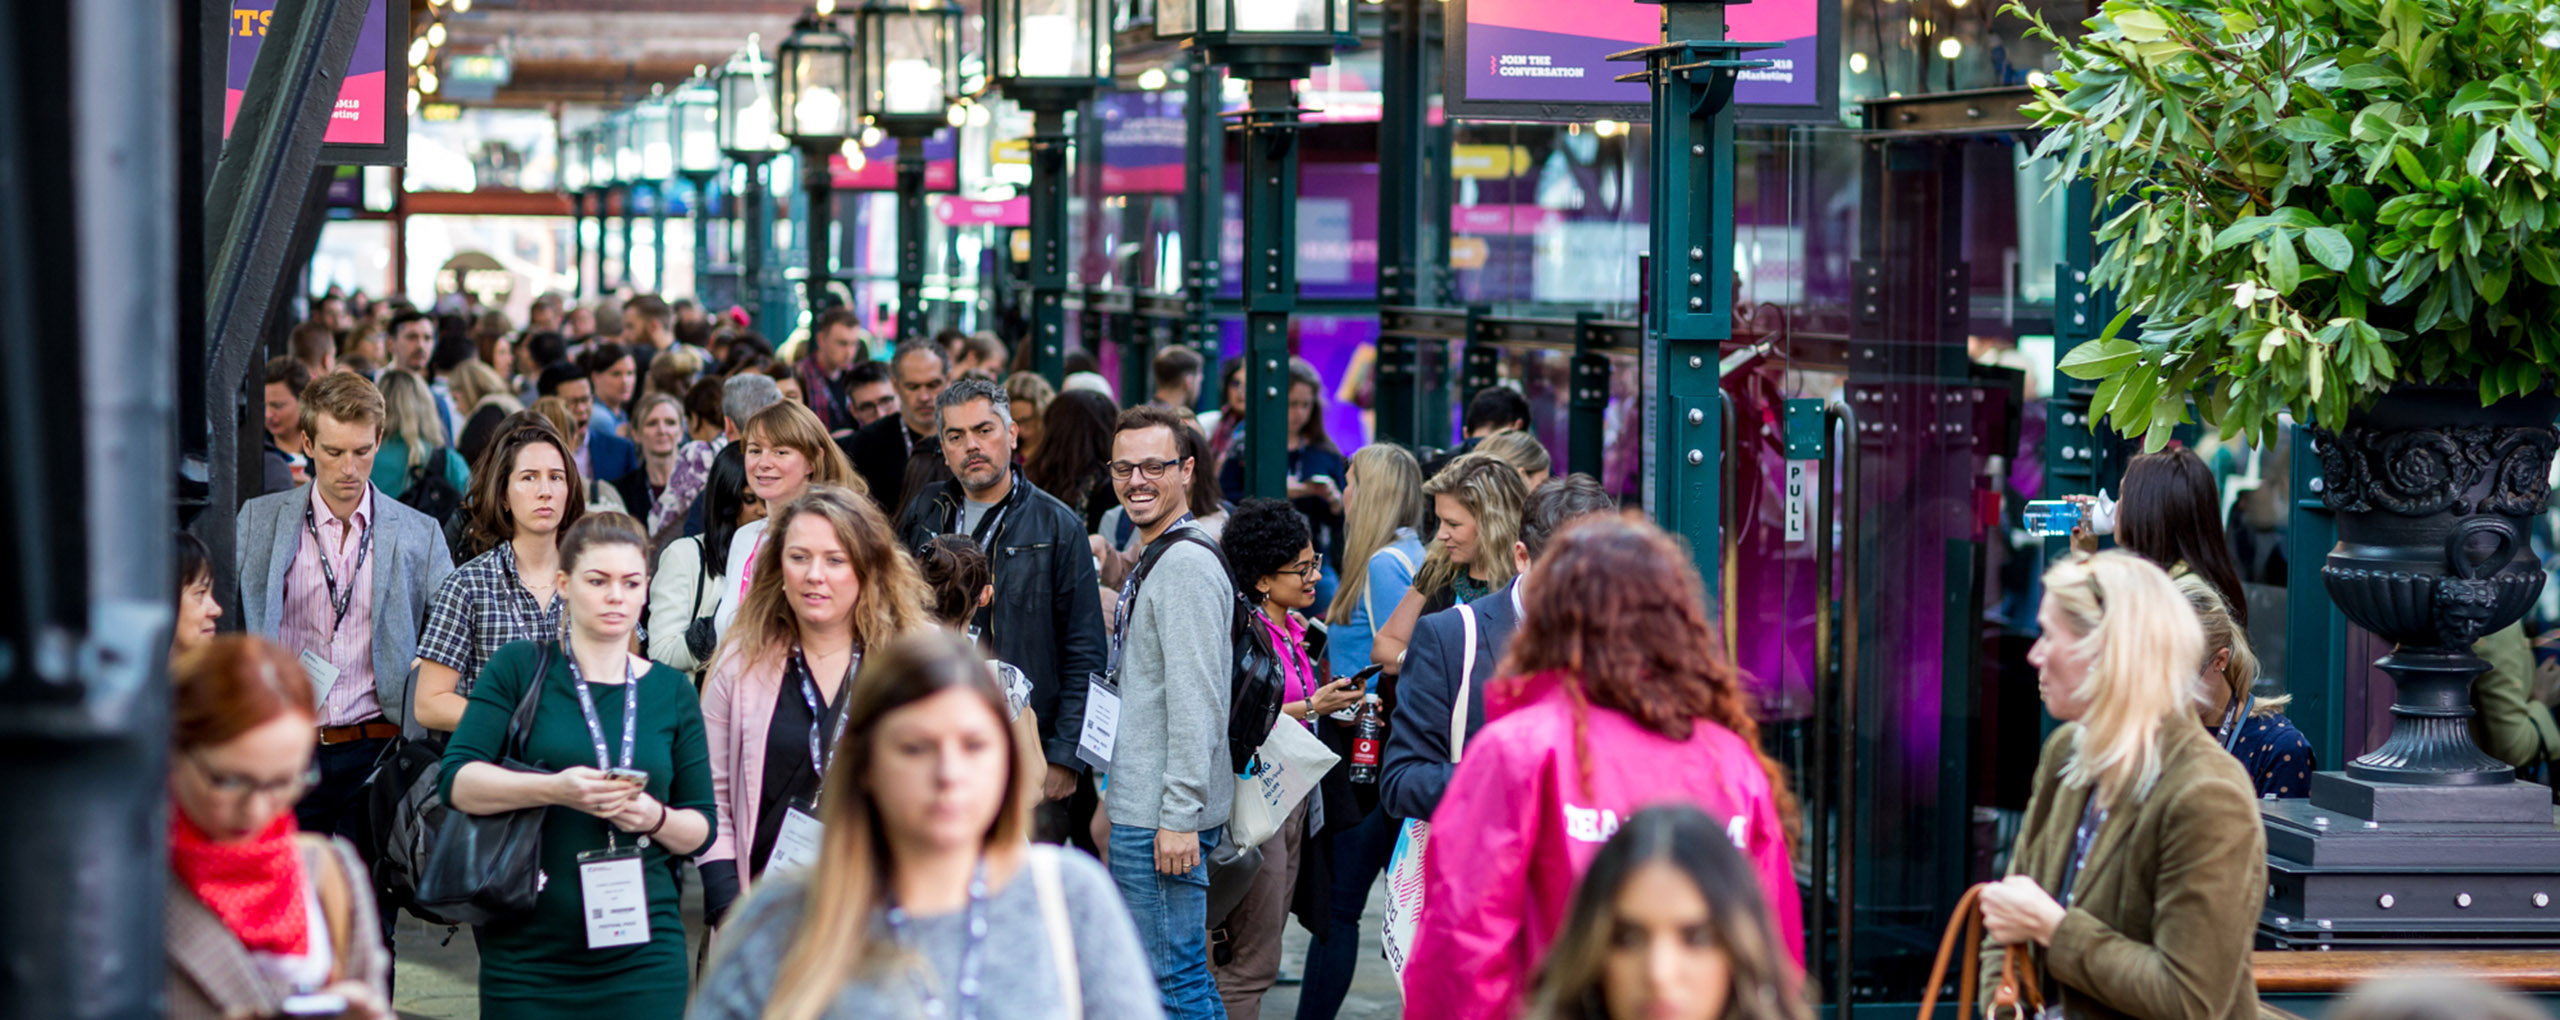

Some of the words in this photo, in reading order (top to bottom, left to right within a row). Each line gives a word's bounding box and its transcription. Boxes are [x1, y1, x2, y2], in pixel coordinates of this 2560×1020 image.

[230, 9, 274, 37] TS
[1500, 54, 1527, 65] JOIN
[1528, 55, 1552, 66] THE
[1500, 66, 1584, 78] CONVERSATION
[331, 110, 360, 121] eting
[1790, 466, 1801, 532] PULL
[1564, 803, 1630, 843] TEA
